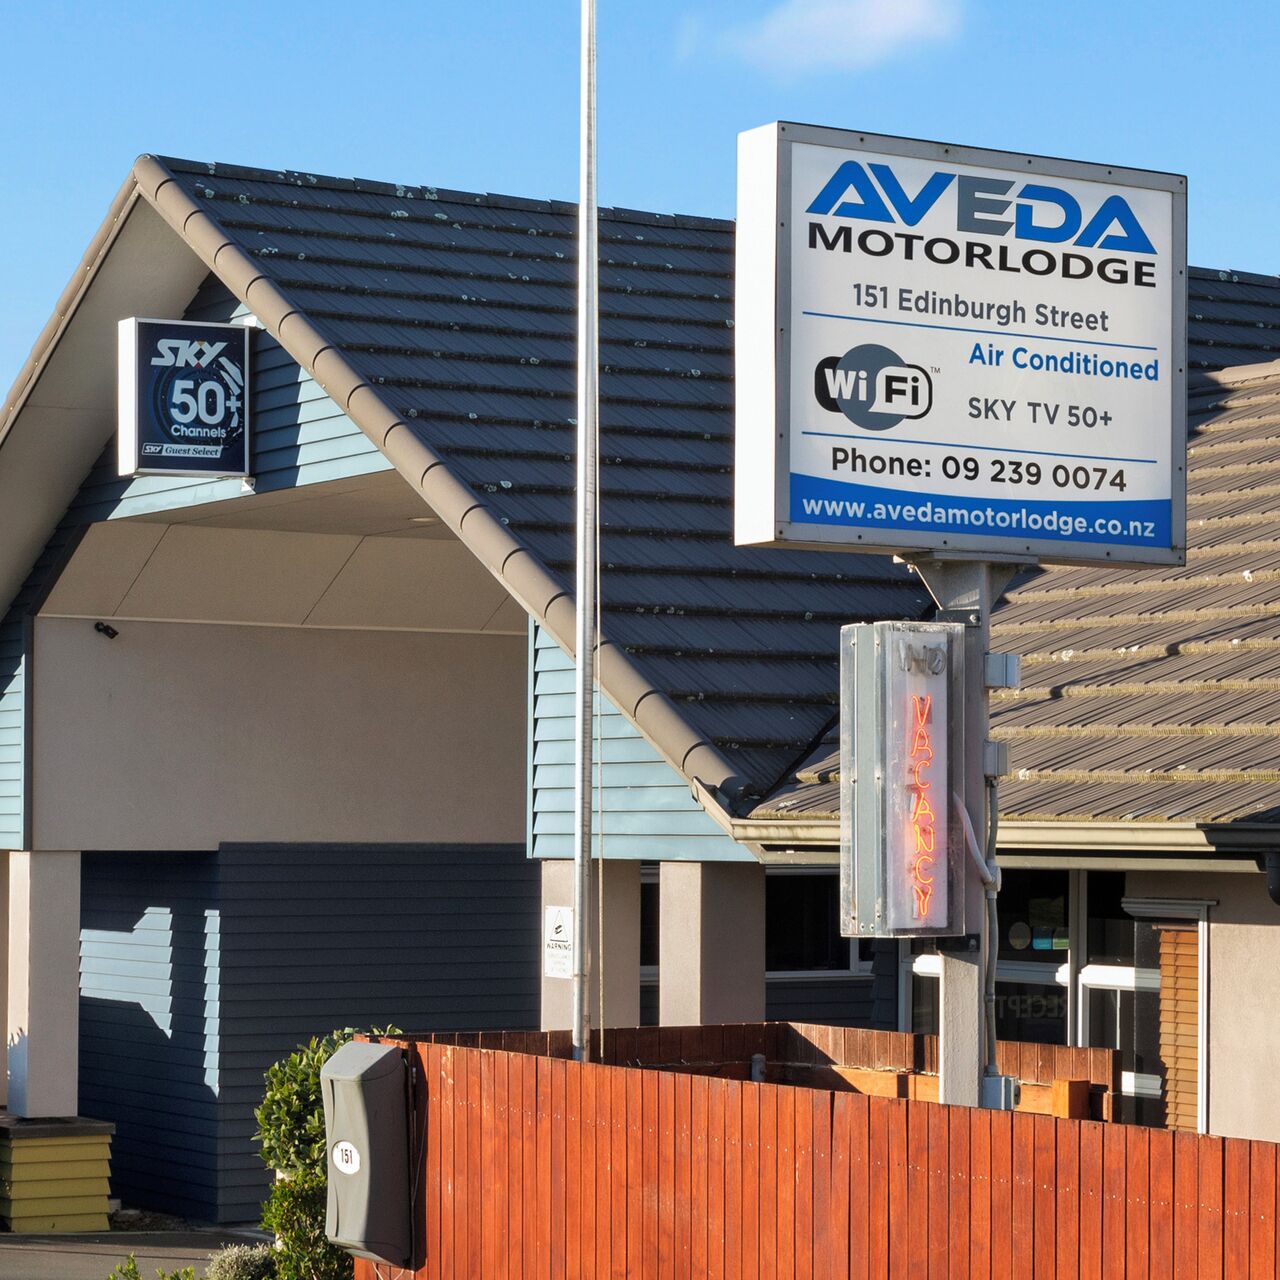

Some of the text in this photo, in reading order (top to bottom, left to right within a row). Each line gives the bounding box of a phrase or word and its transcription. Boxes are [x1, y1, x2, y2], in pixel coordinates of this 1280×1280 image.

[805, 160, 1158, 255] AVEDA
[808, 221, 1157, 288] MOTORLODGE
[852, 283, 1109, 331] 151 Edinburgh Street
[151, 339, 228, 369] SKY
[968, 342, 1159, 382] Air Conditioned
[171, 425, 227, 438] Channels
[968, 396, 1113, 428] SKY TV 50+
[144, 445, 219, 457] SKY Guest Select
[832, 447, 1127, 492] Phone: 09 239 0074
[802, 497, 1156, 538] www.avedamotorlodge.co.nz
[911, 695, 935, 916] VACANCY
[340, 1148, 353, 1165] 151
